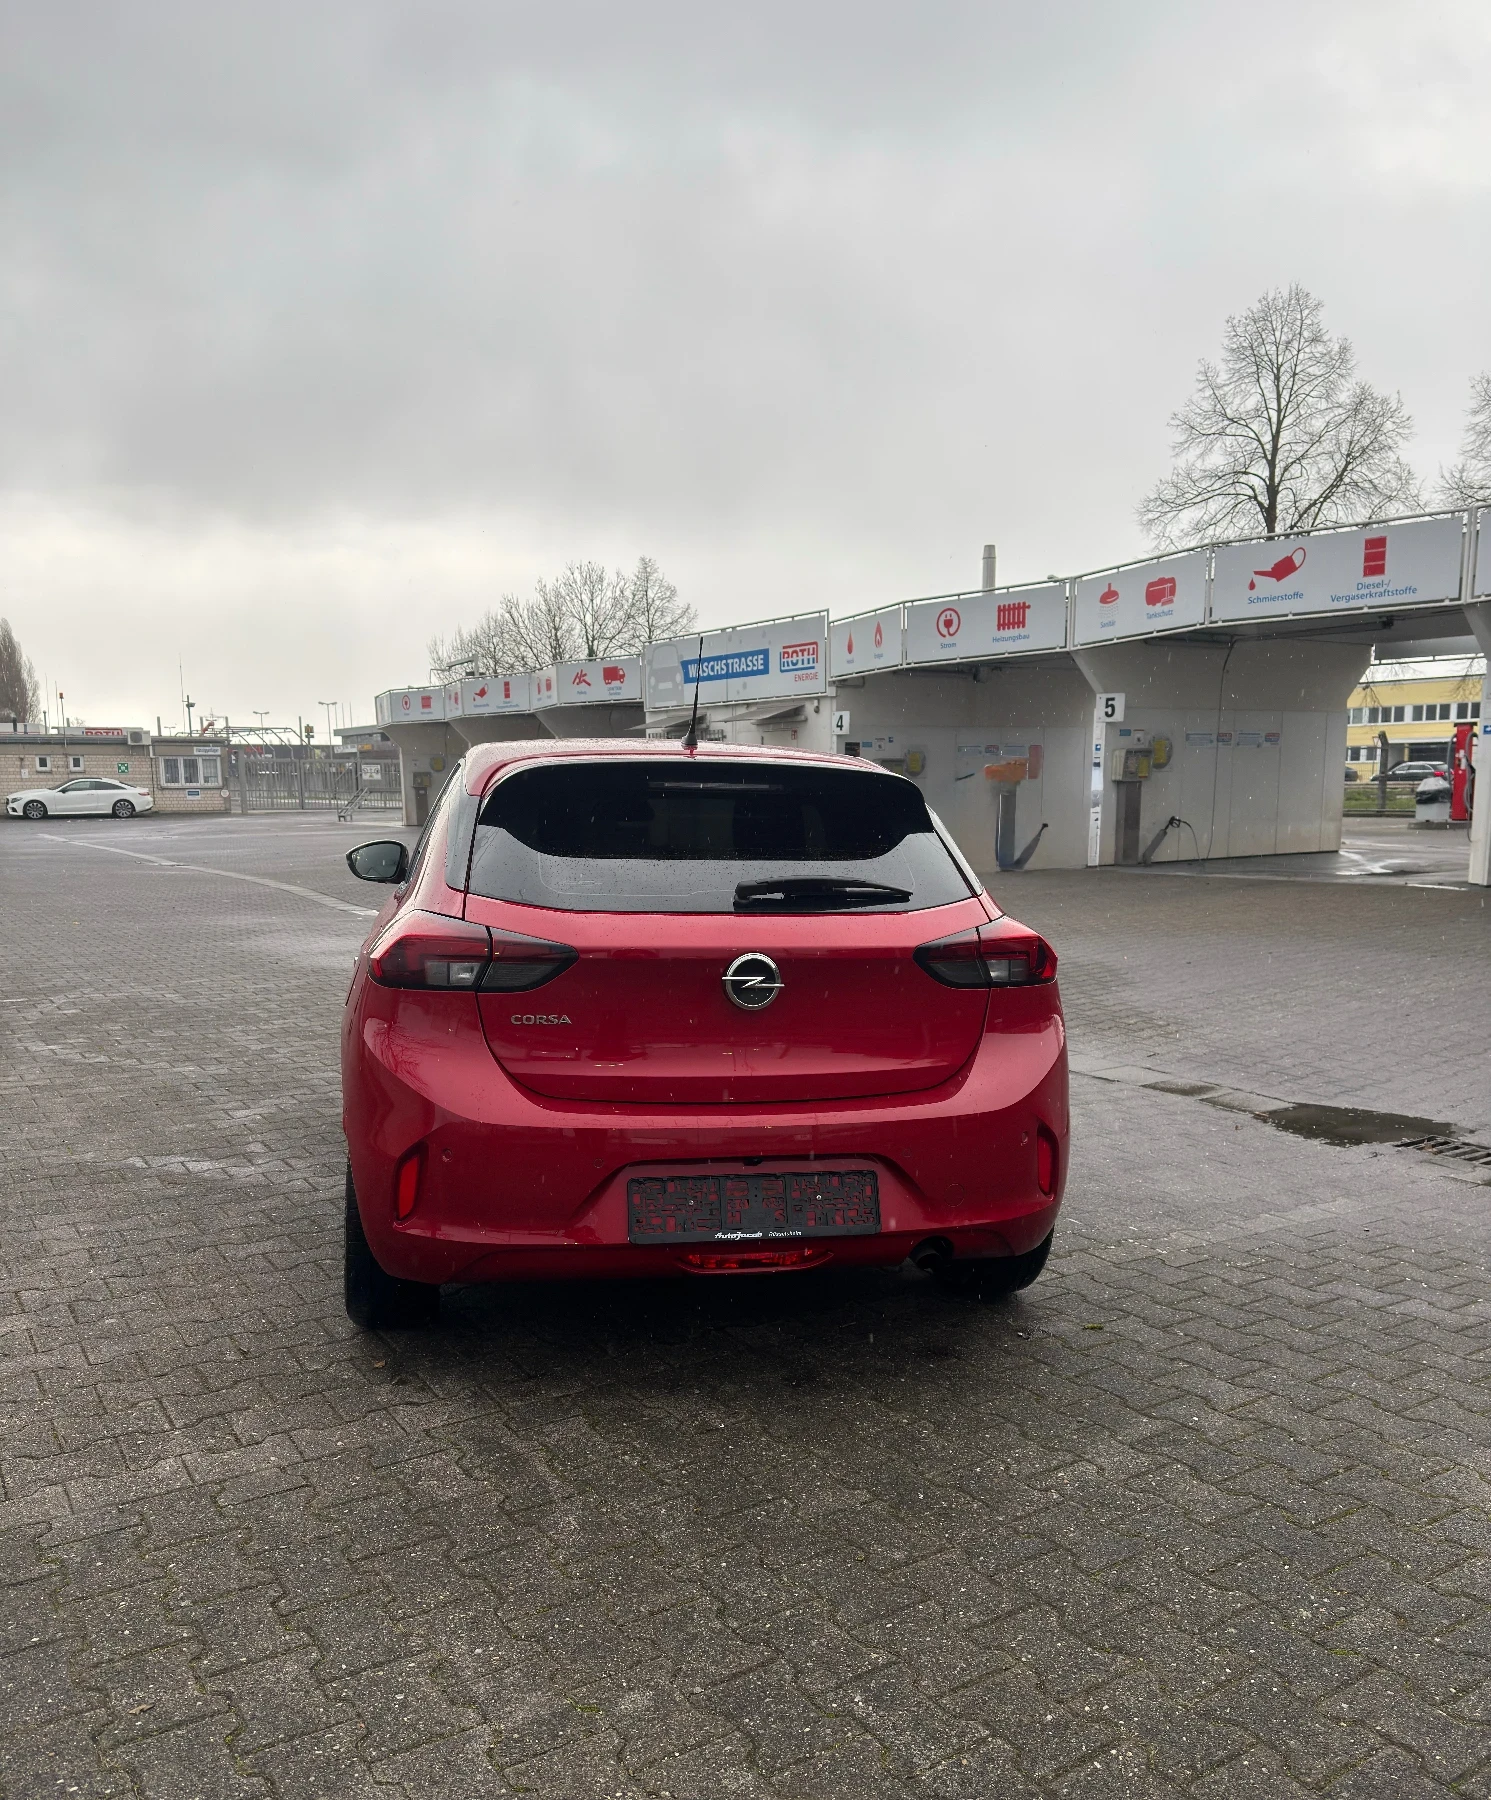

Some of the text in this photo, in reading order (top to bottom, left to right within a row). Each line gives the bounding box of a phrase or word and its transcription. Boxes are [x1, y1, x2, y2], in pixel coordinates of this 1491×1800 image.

[1356, 579, 1391, 591] Diesel-/
[1247, 590, 1304, 605] Schmierstoffe
[1330, 586, 1418, 603] Vergaserkraftstoffe
[1145, 608, 1174, 619] Tankschutz
[939, 641, 957, 649] Strom
[992, 633, 1030, 644] Heizungsbau
[782, 646, 816, 668] ROTH
[688, 655, 764, 678] WASCHSTRASSE
[794, 672, 819, 682] ENERGIE
[1104, 697, 1116, 718] 5
[836, 714, 844, 731] 4
[510, 1014, 572, 1025] CORSA
